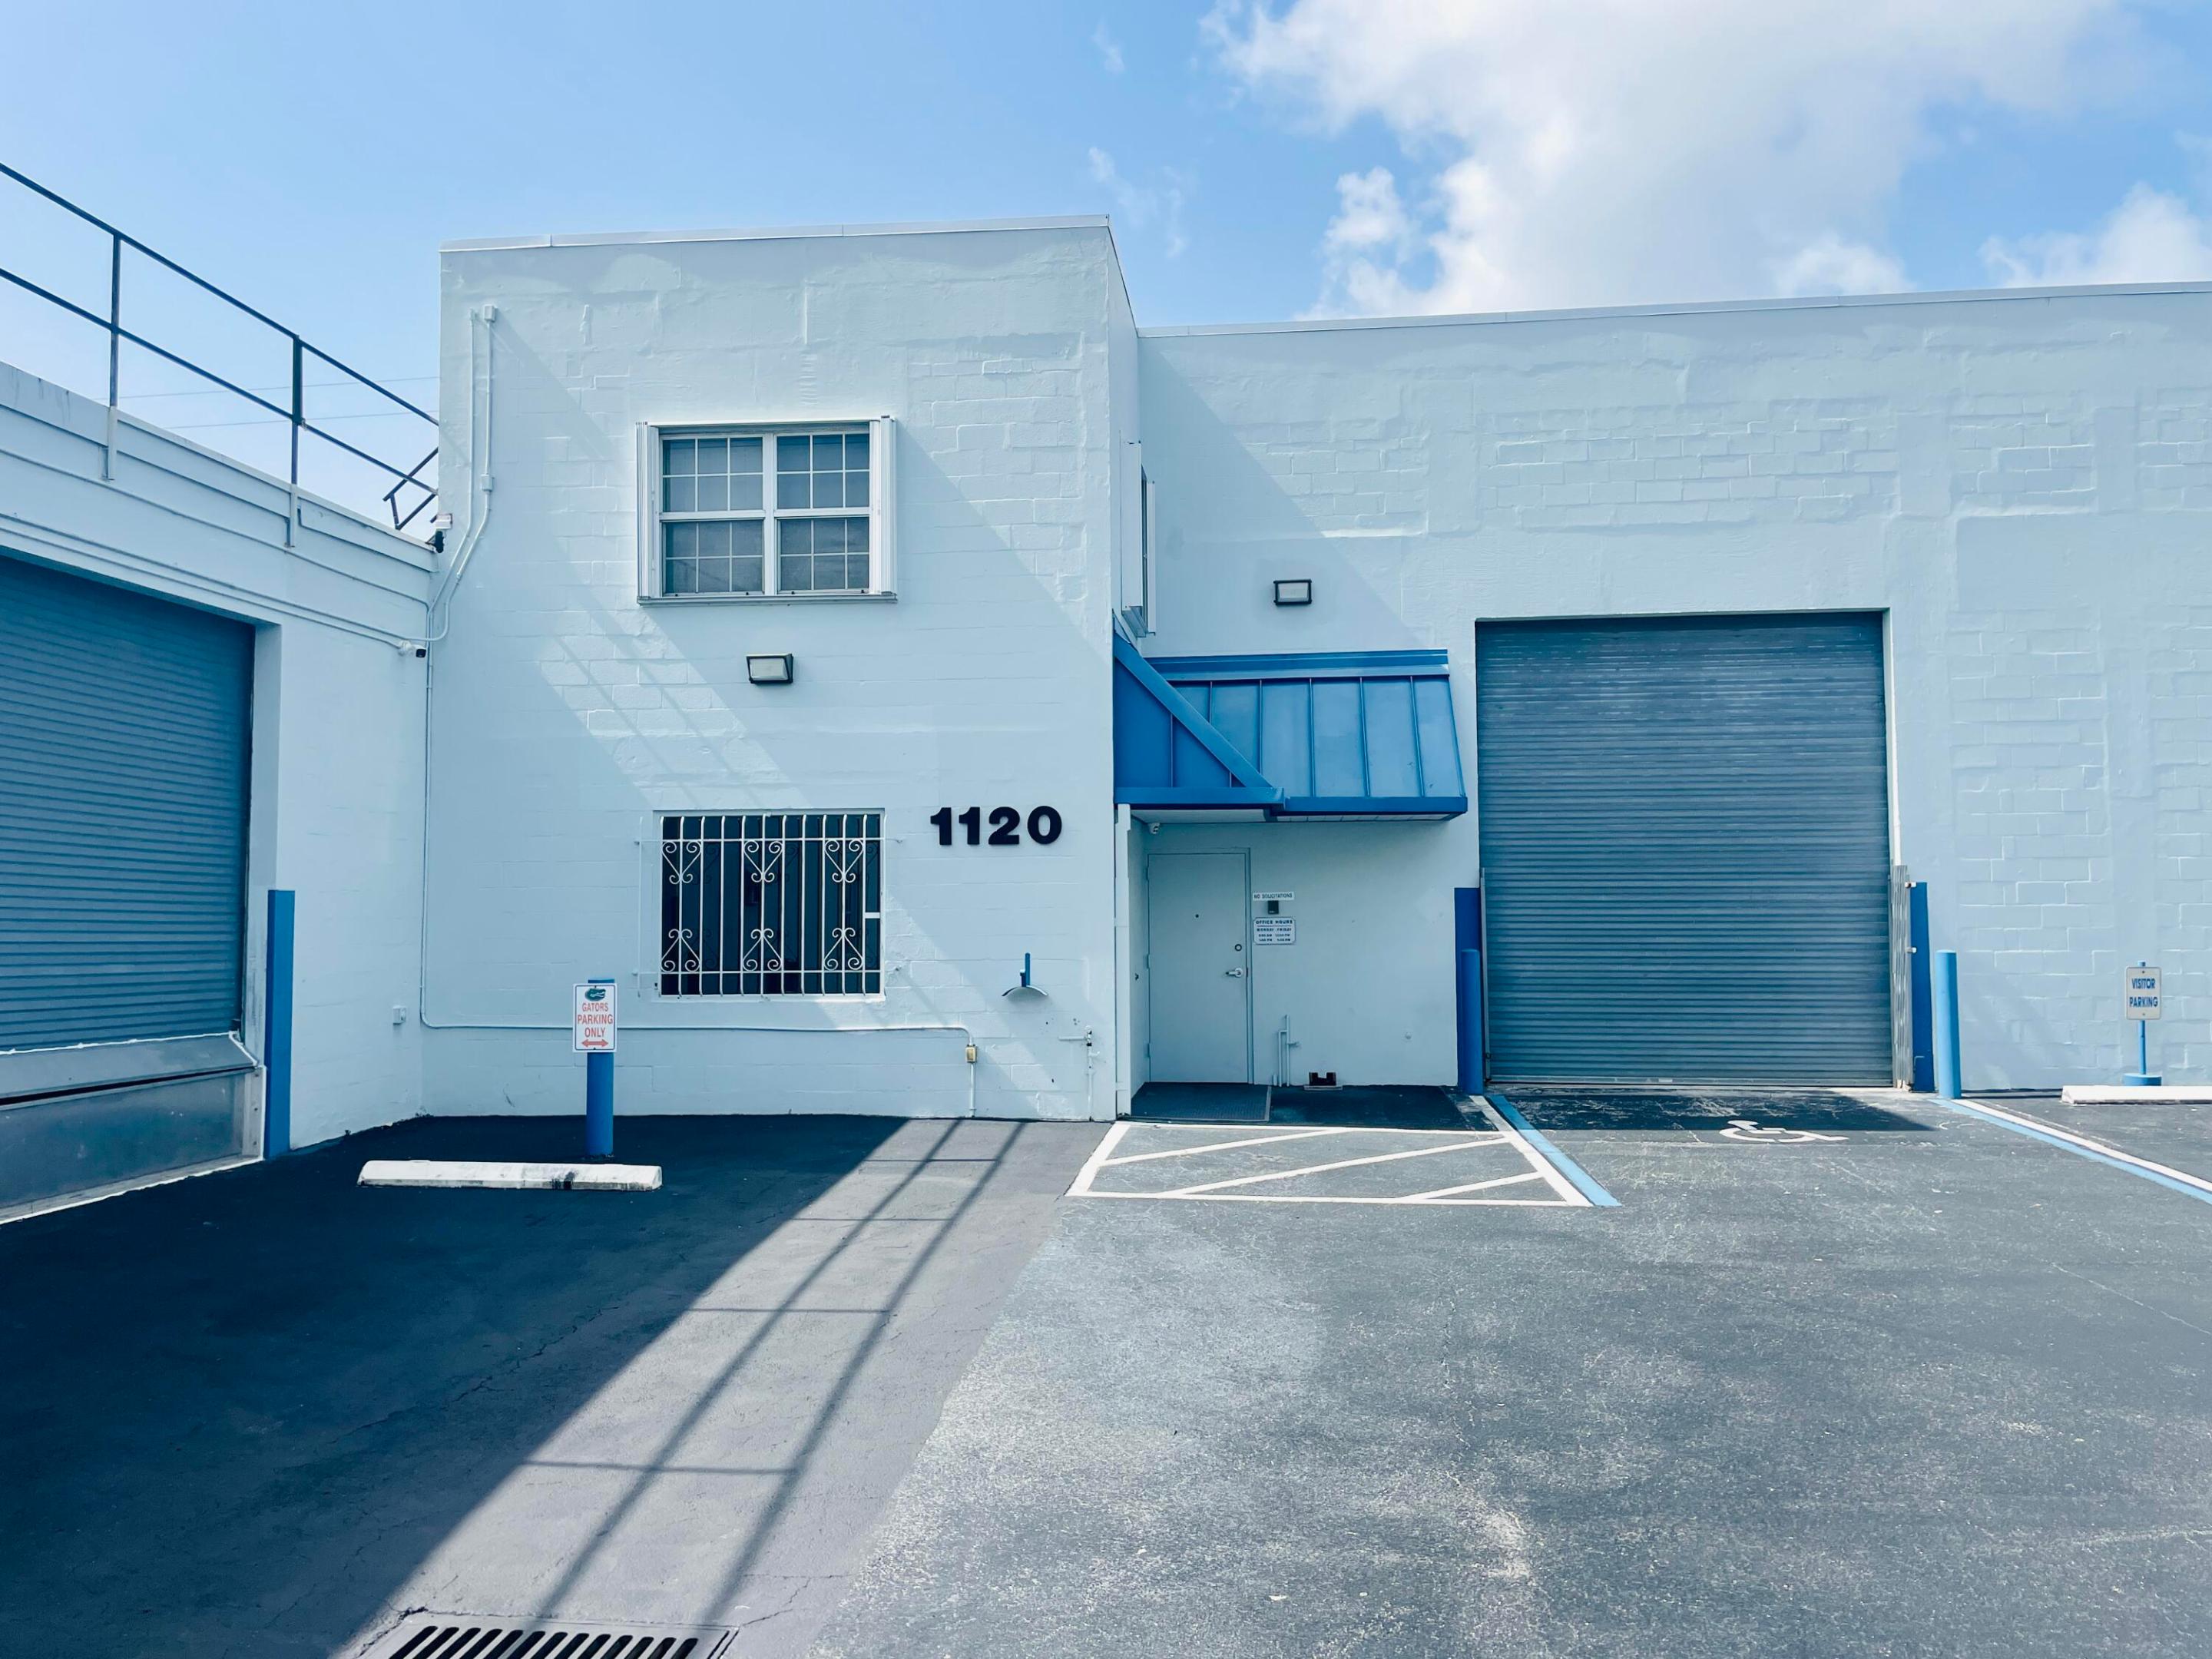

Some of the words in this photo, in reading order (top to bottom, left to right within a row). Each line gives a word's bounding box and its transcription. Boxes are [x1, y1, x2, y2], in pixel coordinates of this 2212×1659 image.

[930, 806, 1062, 846] 1120
[2131, 978, 2156, 989] VISITOR
[581, 1002, 609, 1012] GATORS
[2129, 996, 2158, 1008] PARKING
[577, 1014, 613, 1025] PARKING
[584, 1027, 606, 1038] ONLY
